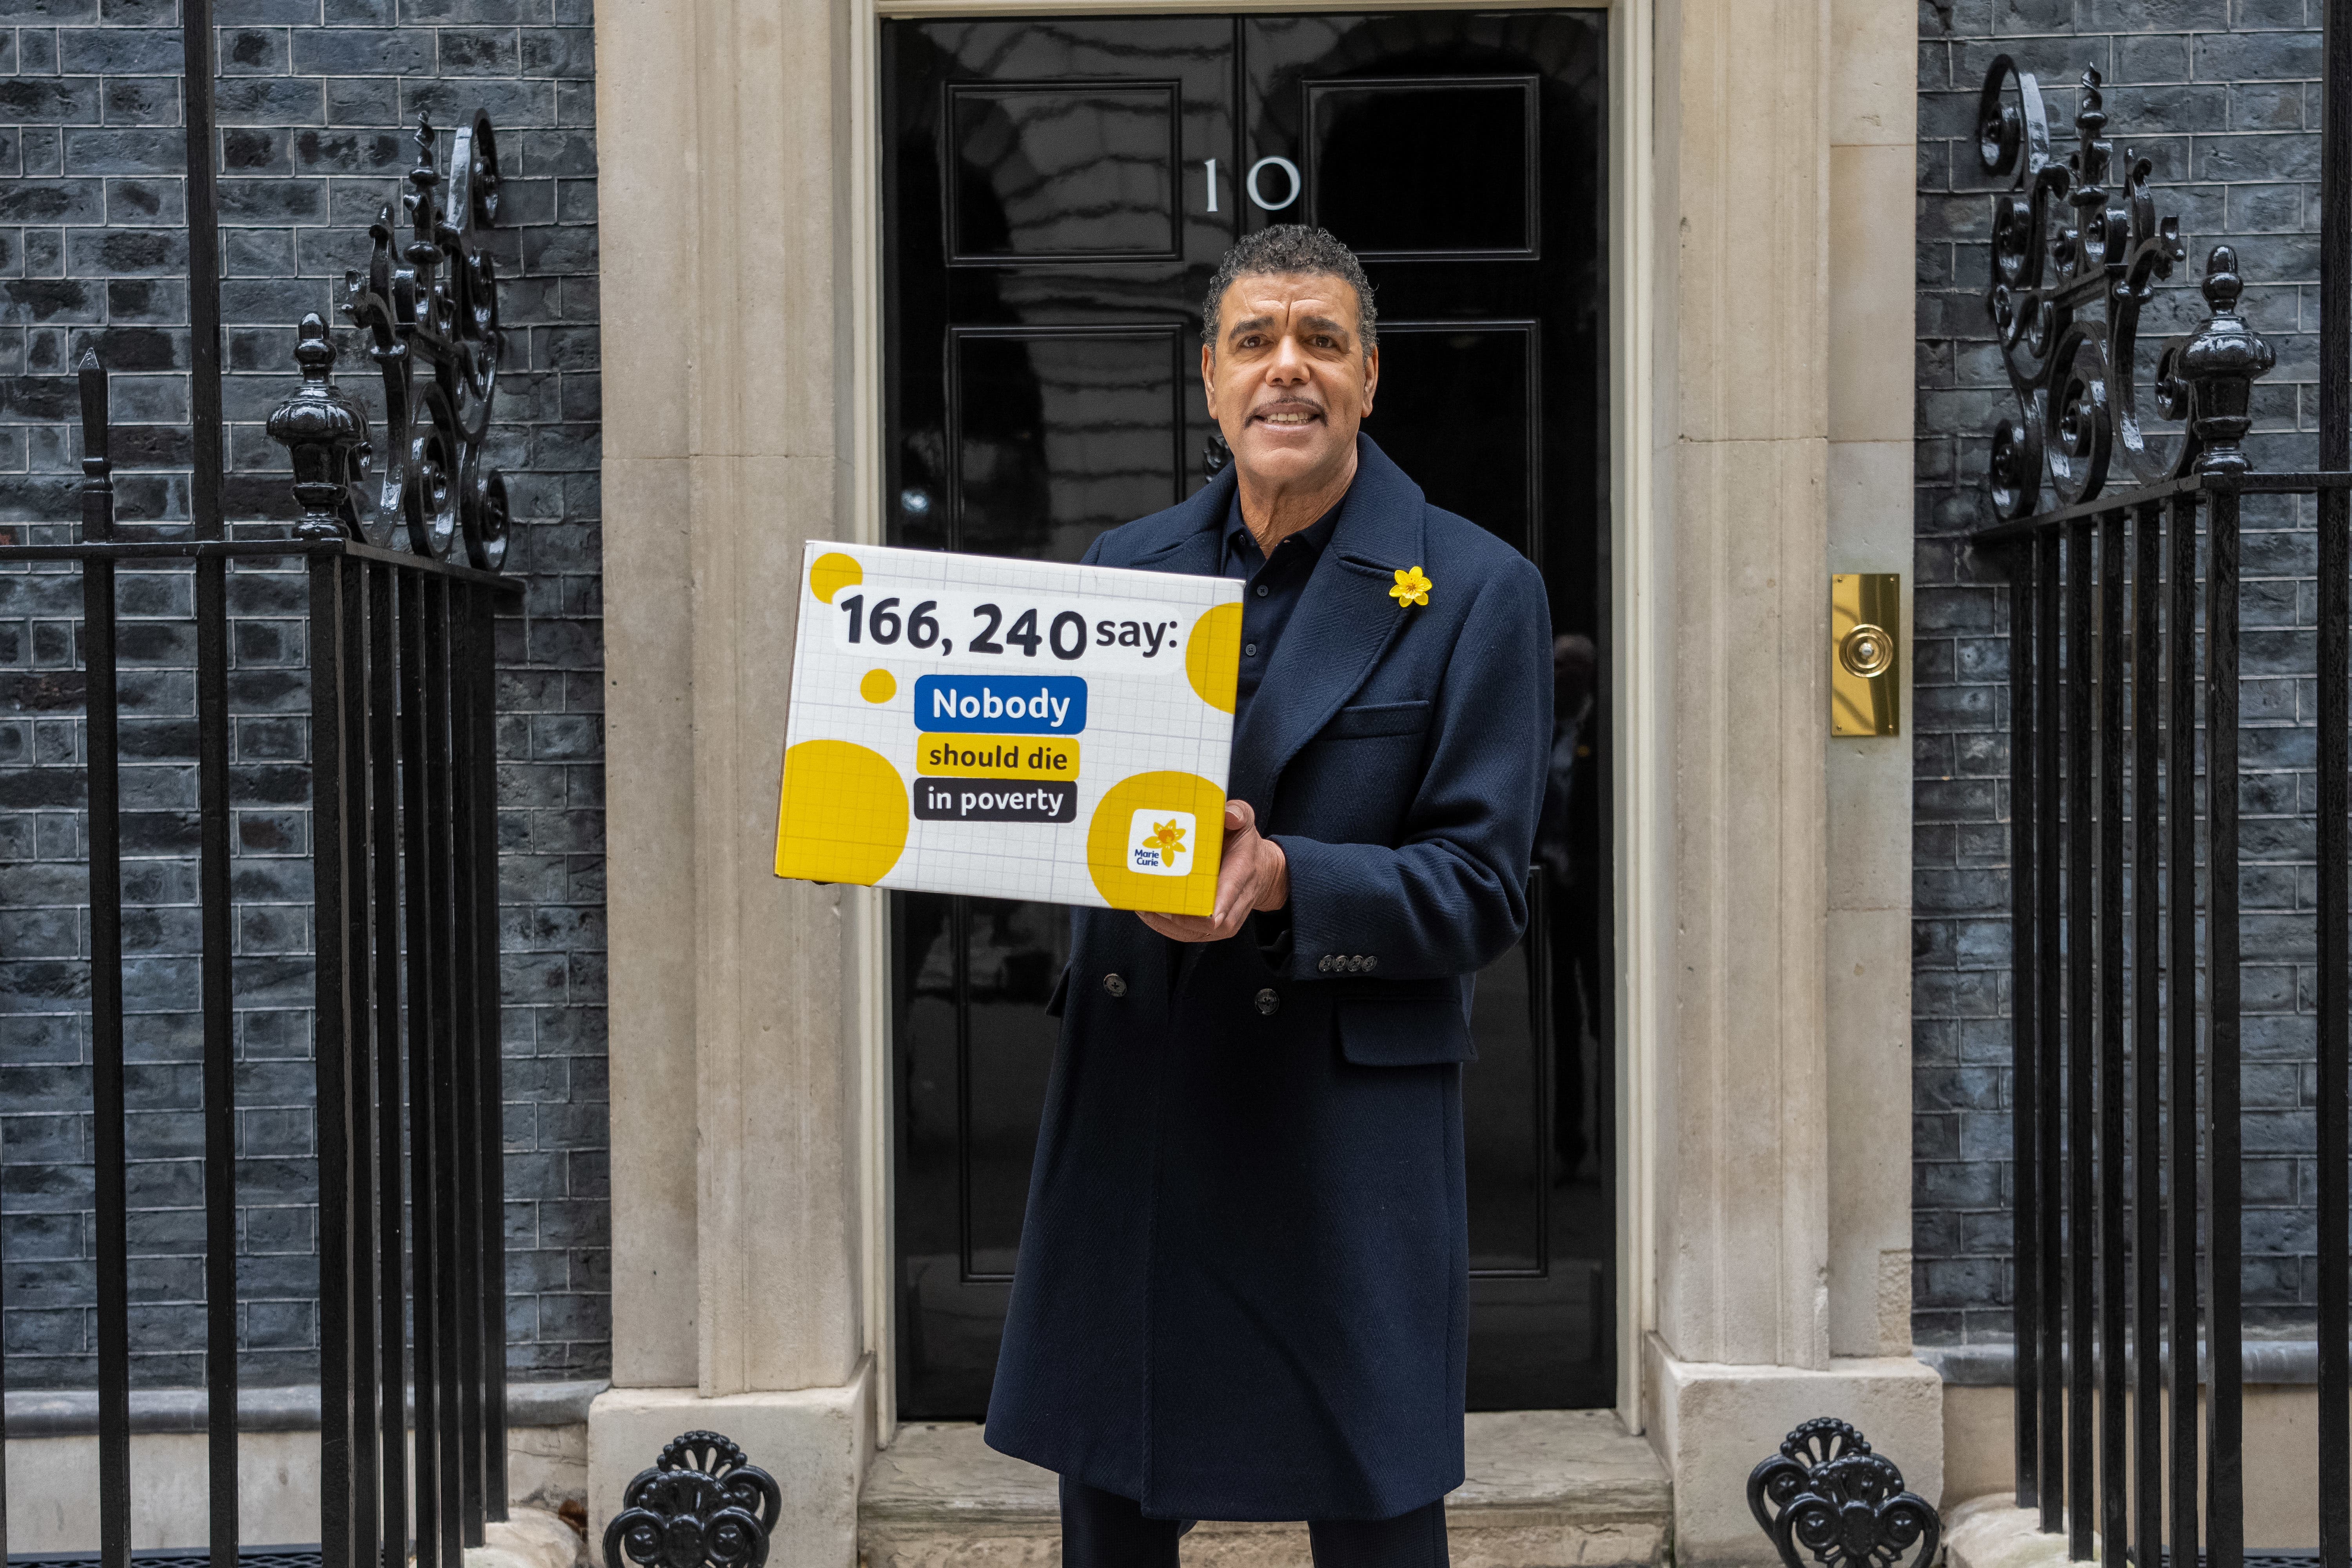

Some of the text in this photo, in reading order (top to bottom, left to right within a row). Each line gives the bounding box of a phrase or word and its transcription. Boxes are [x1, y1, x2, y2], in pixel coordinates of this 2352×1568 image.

[1204, 156, 1301, 212] 10
[1096, 621, 1177, 658] say:
[933, 687, 1071, 727] Nobody
[929, 743, 1067, 770] should die
[928, 786, 1064, 816] in poverty
[1134, 849, 1159, 858] Marie
[1136, 857, 1158, 866] Curie
